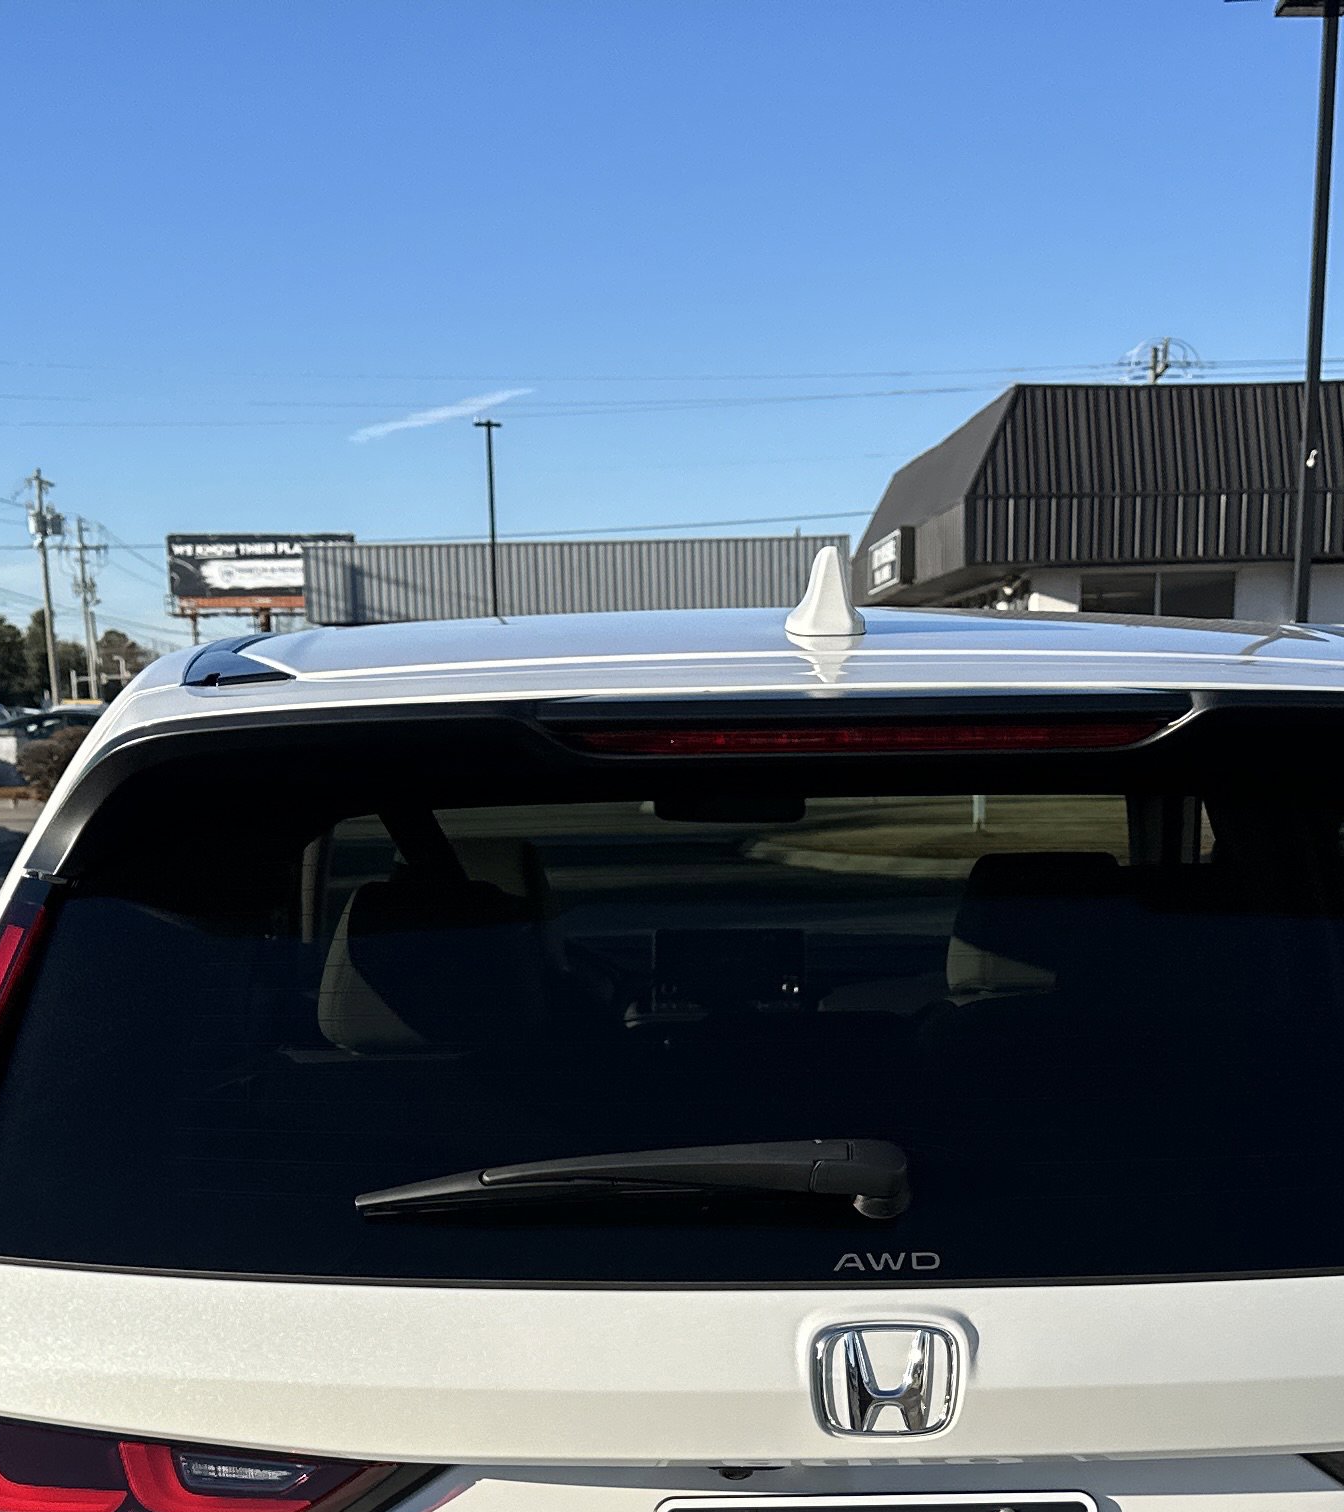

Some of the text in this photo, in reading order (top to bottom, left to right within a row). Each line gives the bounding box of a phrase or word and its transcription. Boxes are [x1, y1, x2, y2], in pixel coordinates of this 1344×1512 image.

[195, 543, 236, 557] KNOW
[238, 542, 275, 555] THEIR
[833, 1252, 941, 1271] AWD
